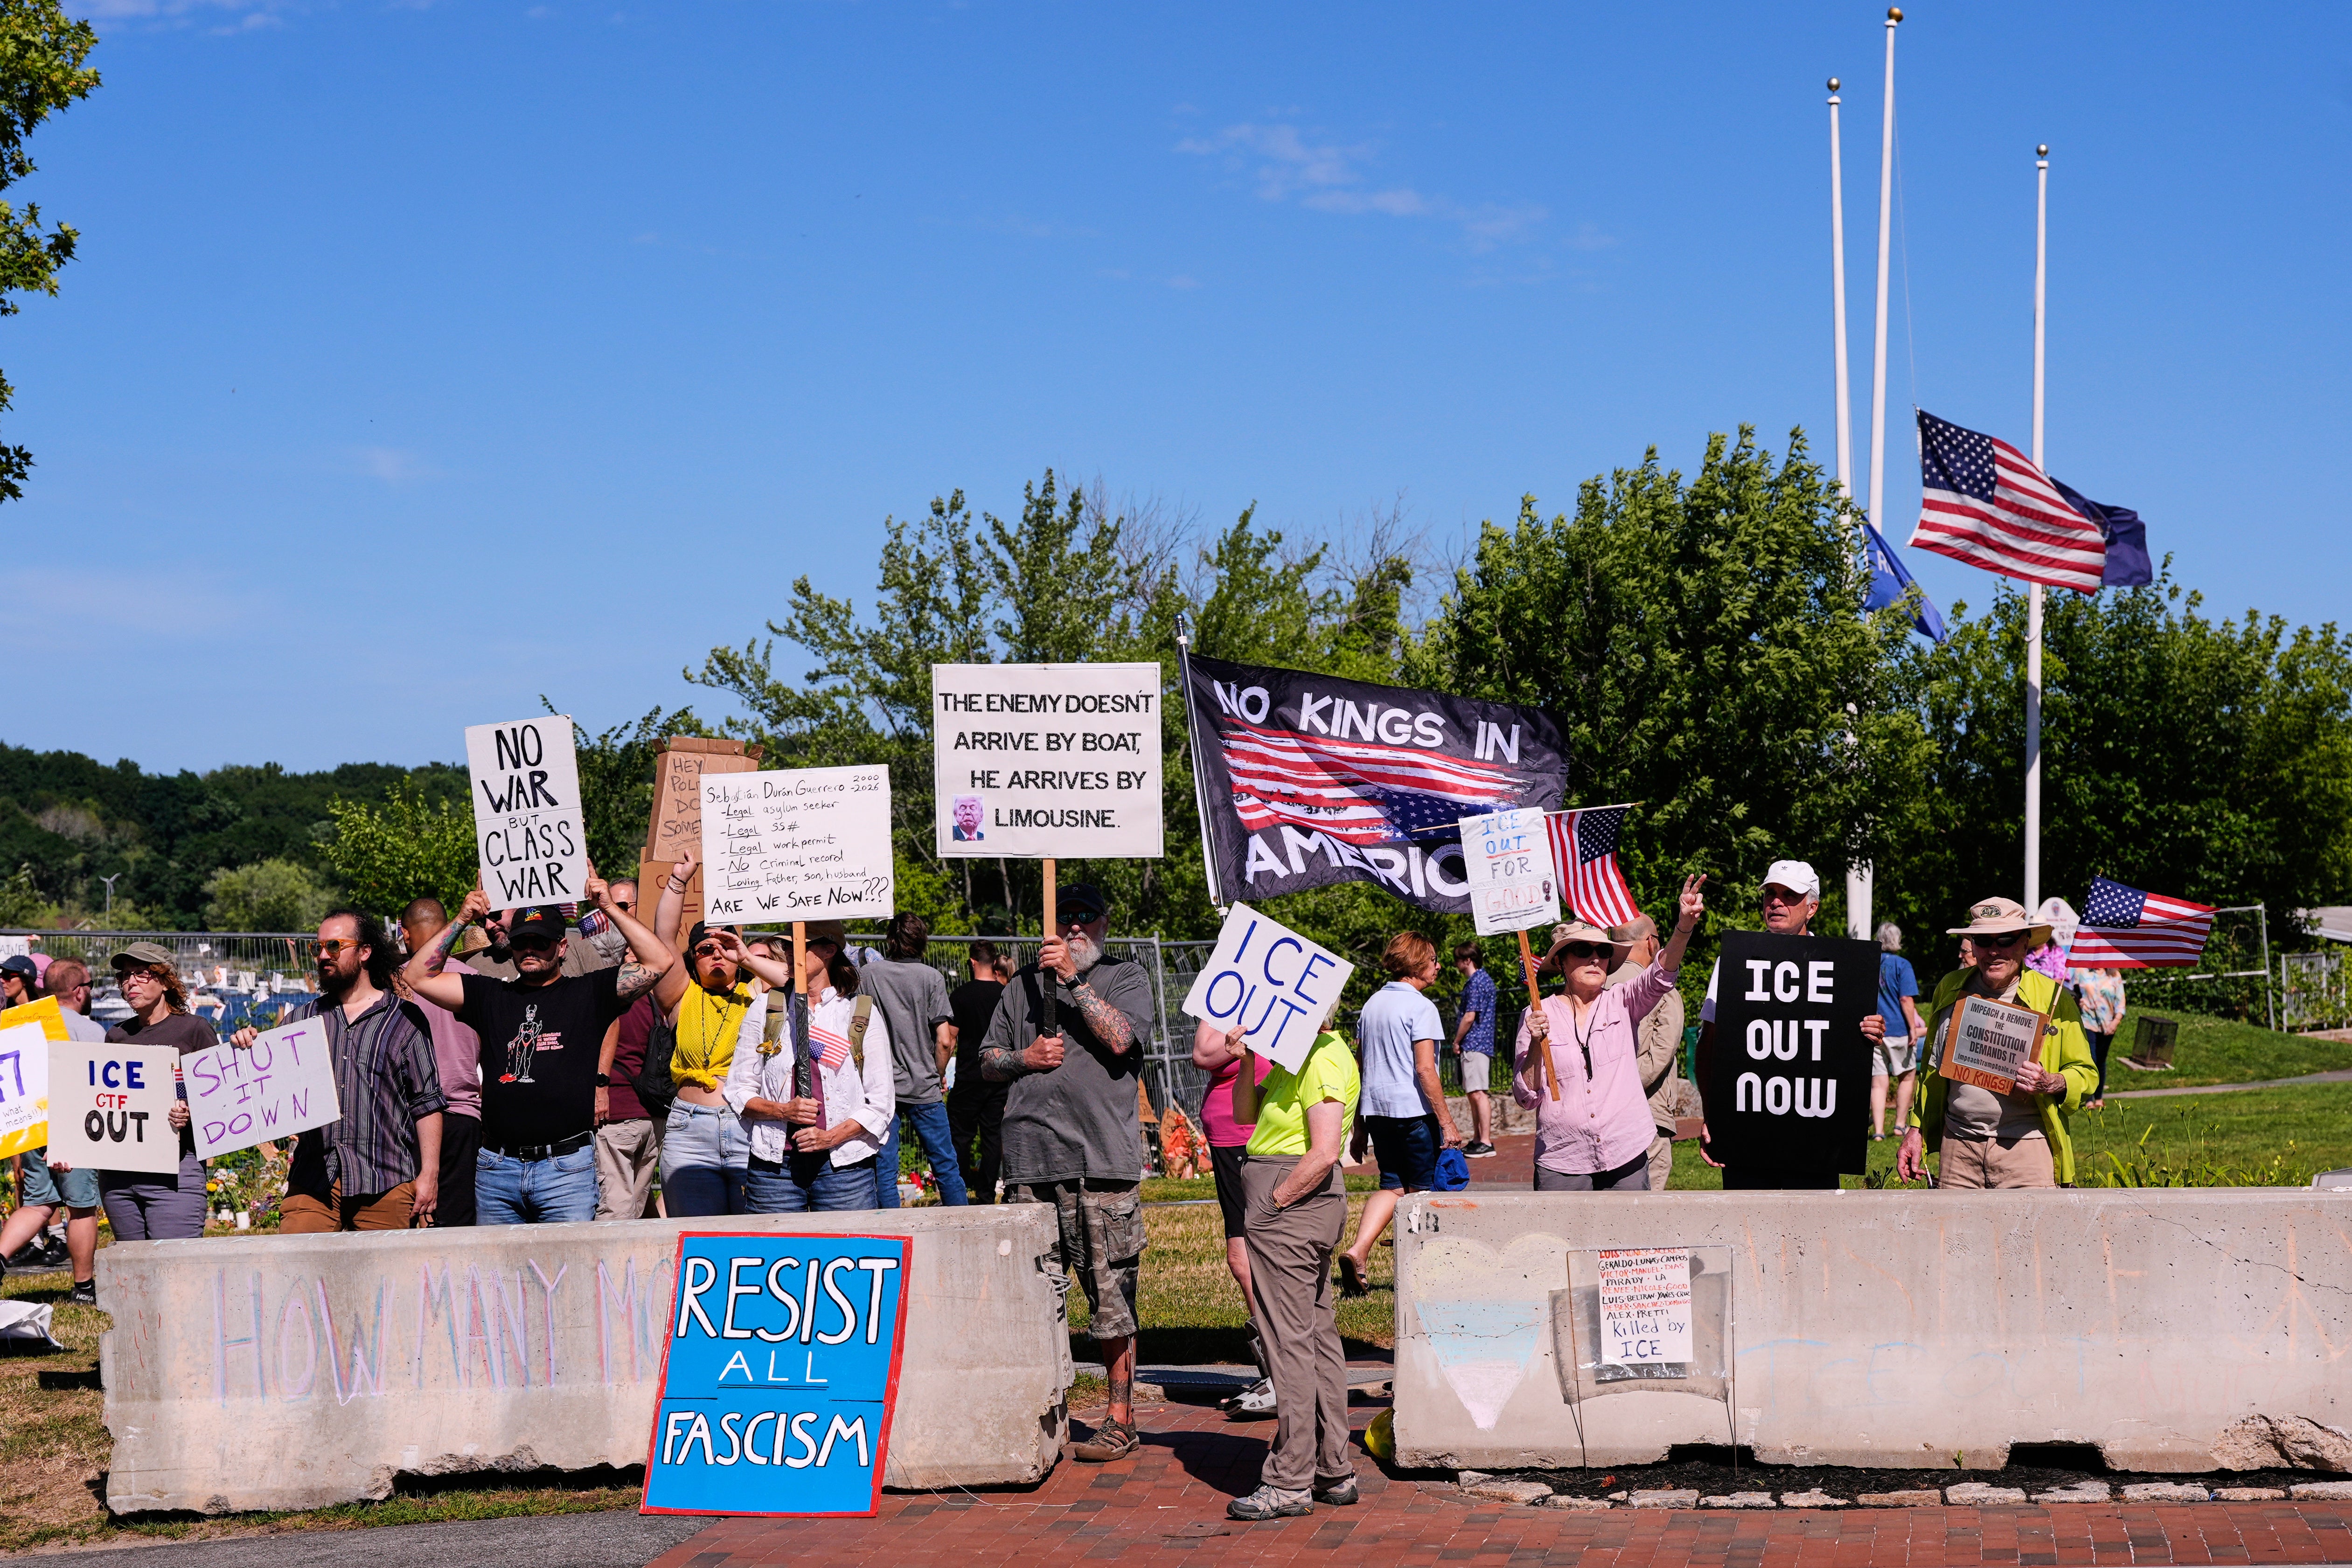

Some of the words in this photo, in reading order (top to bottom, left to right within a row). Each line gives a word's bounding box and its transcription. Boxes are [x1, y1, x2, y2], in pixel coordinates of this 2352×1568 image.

[939, 693, 982, 712] THE
[986, 694, 1063, 713] ENEMY
[1214, 679, 1270, 724] NO
[1298, 692, 1446, 748] KINGS
[1474, 720, 1521, 764] IN
[495, 724, 542, 770] NO
[953, 731, 1039, 751] ARRIVE
[1046, 732, 1076, 751] BY
[1082, 732, 1141, 755] BOAT,
[672, 758, 703, 774] HEY
[481, 770, 559, 813] WAR
[706, 785, 758, 803] Sebastián
[764, 782, 793, 799] Durán
[795, 780, 844, 795] Guerrero
[971, 770, 1001, 789] HE
[1007, 770, 1109, 790] ARRIVES
[1117, 770, 1147, 790] BY
[509, 814, 539, 829] BUT
[763, 801, 798, 820] asylum
[803, 800, 840, 811] seeker
[995, 808, 1121, 828] LIMOUSINE.
[1481, 811, 1523, 836] ICE
[485, 820, 575, 867] CLASS
[773, 837, 800, 849] work
[801, 833, 837, 849] permit
[809, 849, 844, 863] record
[1491, 856, 1531, 879] FOR
[496, 861, 571, 902] WAR
[826, 867, 867, 879] husband
[711, 897, 743, 915] ARE
[756, 893, 780, 910] WE
[786, 891, 822, 907] SAFE
[1233, 920, 1336, 1005] ICE
[1745, 959, 1834, 1003] ICE
[1205, 970, 1308, 1048] OUT
[1970, 1003, 2000, 1019] IMPEACH
[2000, 1012, 2005, 1020] &
[2006, 1013, 2033, 1029] REMOVE.
[1995, 1021, 2005, 1030] THE
[1747, 1019, 1830, 1061] OUT
[1967, 1024, 2027, 1053] CONSTITUTION
[193, 1030, 306, 1097] SHUT
[1957, 1053, 2018, 1076] ImpeachTrumpAgain.org
[1969, 1041, 2007, 1062] DEMANDS
[2008, 1052, 2017, 1065] IT.
[89, 1060, 145, 1089] ICE
[1953, 1064, 1970, 1082] NO
[233, 1074, 272, 1105] IT
[1736, 1072, 1837, 1118] NOW
[3, 1104, 23, 1117] what
[96, 1093, 128, 1110] GTF
[84, 1110, 149, 1143] OUT
[202, 1087, 308, 1145] DOWN
[150, 1237, 259, 1246] FUCK
[509, 1222, 579, 1231] FUCK
[1598, 1260, 1633, 1271] GERALDO
[1660, 1255, 1688, 1263] CAMPOS
[1600, 1269, 1630, 1279] VICTOR
[1631, 1266, 1661, 1275] MANUEL
[1602, 1286, 1630, 1295] RENEE
[1633, 1284, 1664, 1293] NICOLE
[1665, 1283, 1688, 1291] GOOD
[1606, 1276, 1643, 1286] PARADY
[76, 1293, 93, 1302] HOKA
[676, 1256, 900, 1345] RESIST
[1602, 1296, 1625, 1304] LUIS
[1627, 1292, 1655, 1302] BELTRAN
[1603, 1303, 1630, 1312] HEBER
[1631, 1301, 1664, 1310] SANCHEZ
[1606, 1311, 1632, 1320] ALEX
[1637, 1309, 1669, 1318] PRETTI
[212, 1266, 395, 1408] HOW
[415, 1256, 567, 1393] MANY
[1613, 1318, 1659, 1338] Killed
[1667, 1318, 1685, 1333] by
[1621, 1339, 1663, 1359] ICE
[718, 1349, 828, 1383] ALL
[661, 1411, 870, 1469] FASCISM
